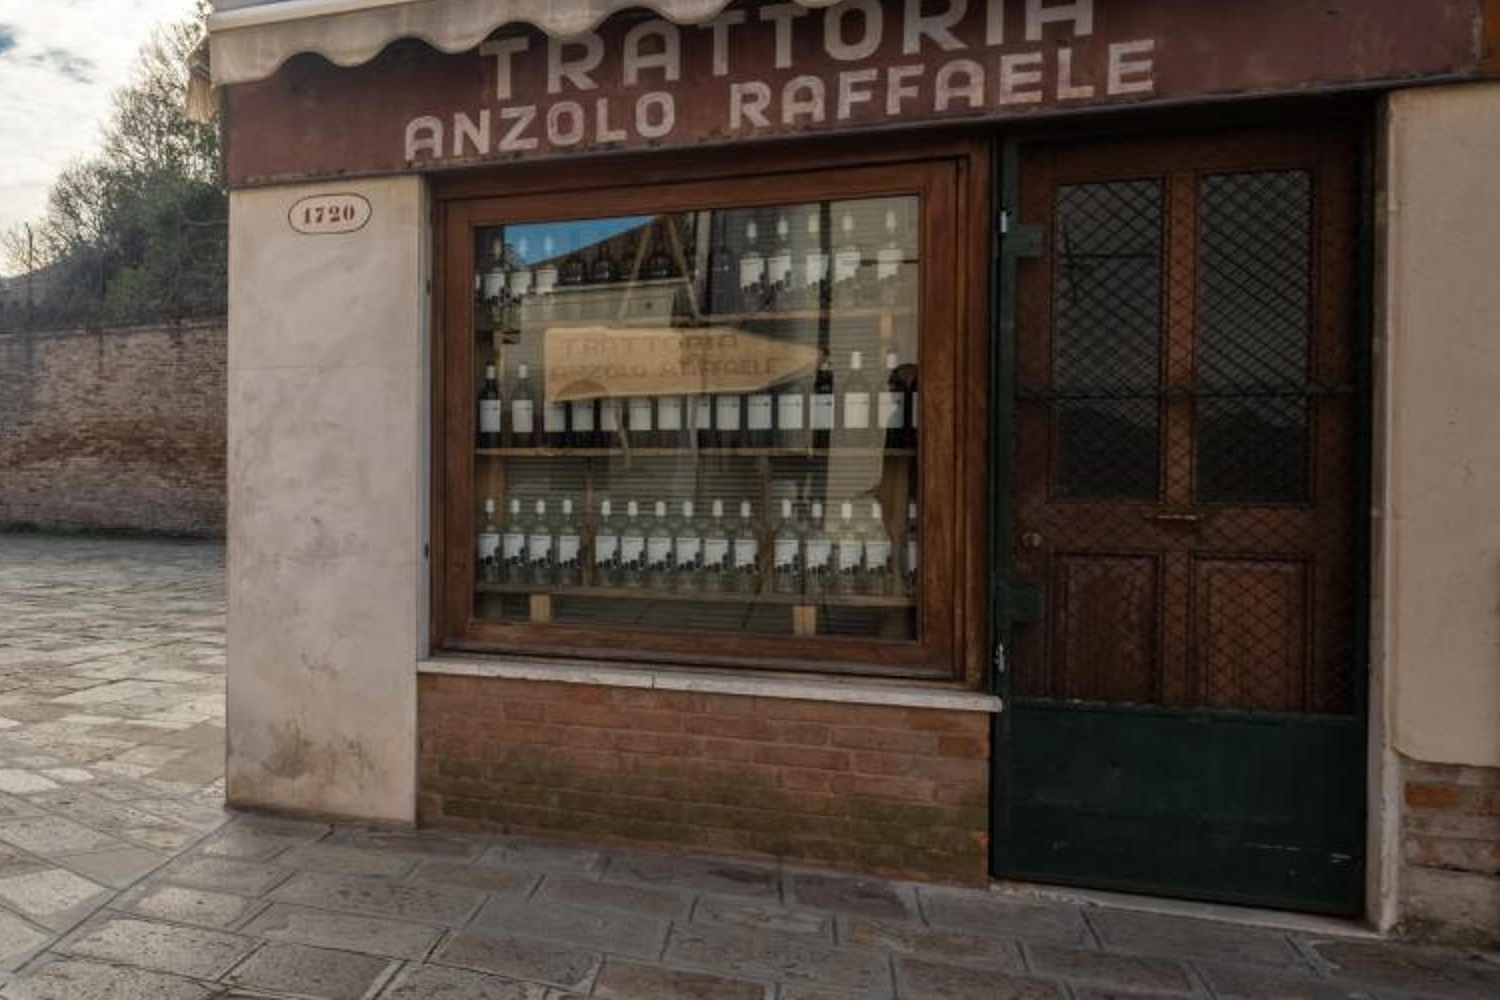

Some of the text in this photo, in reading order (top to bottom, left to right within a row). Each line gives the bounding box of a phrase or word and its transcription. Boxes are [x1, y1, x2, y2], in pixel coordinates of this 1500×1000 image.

[404, 39, 1155, 161] ANZOLO RAFFAELE
[304, 204, 355, 224] 1720
